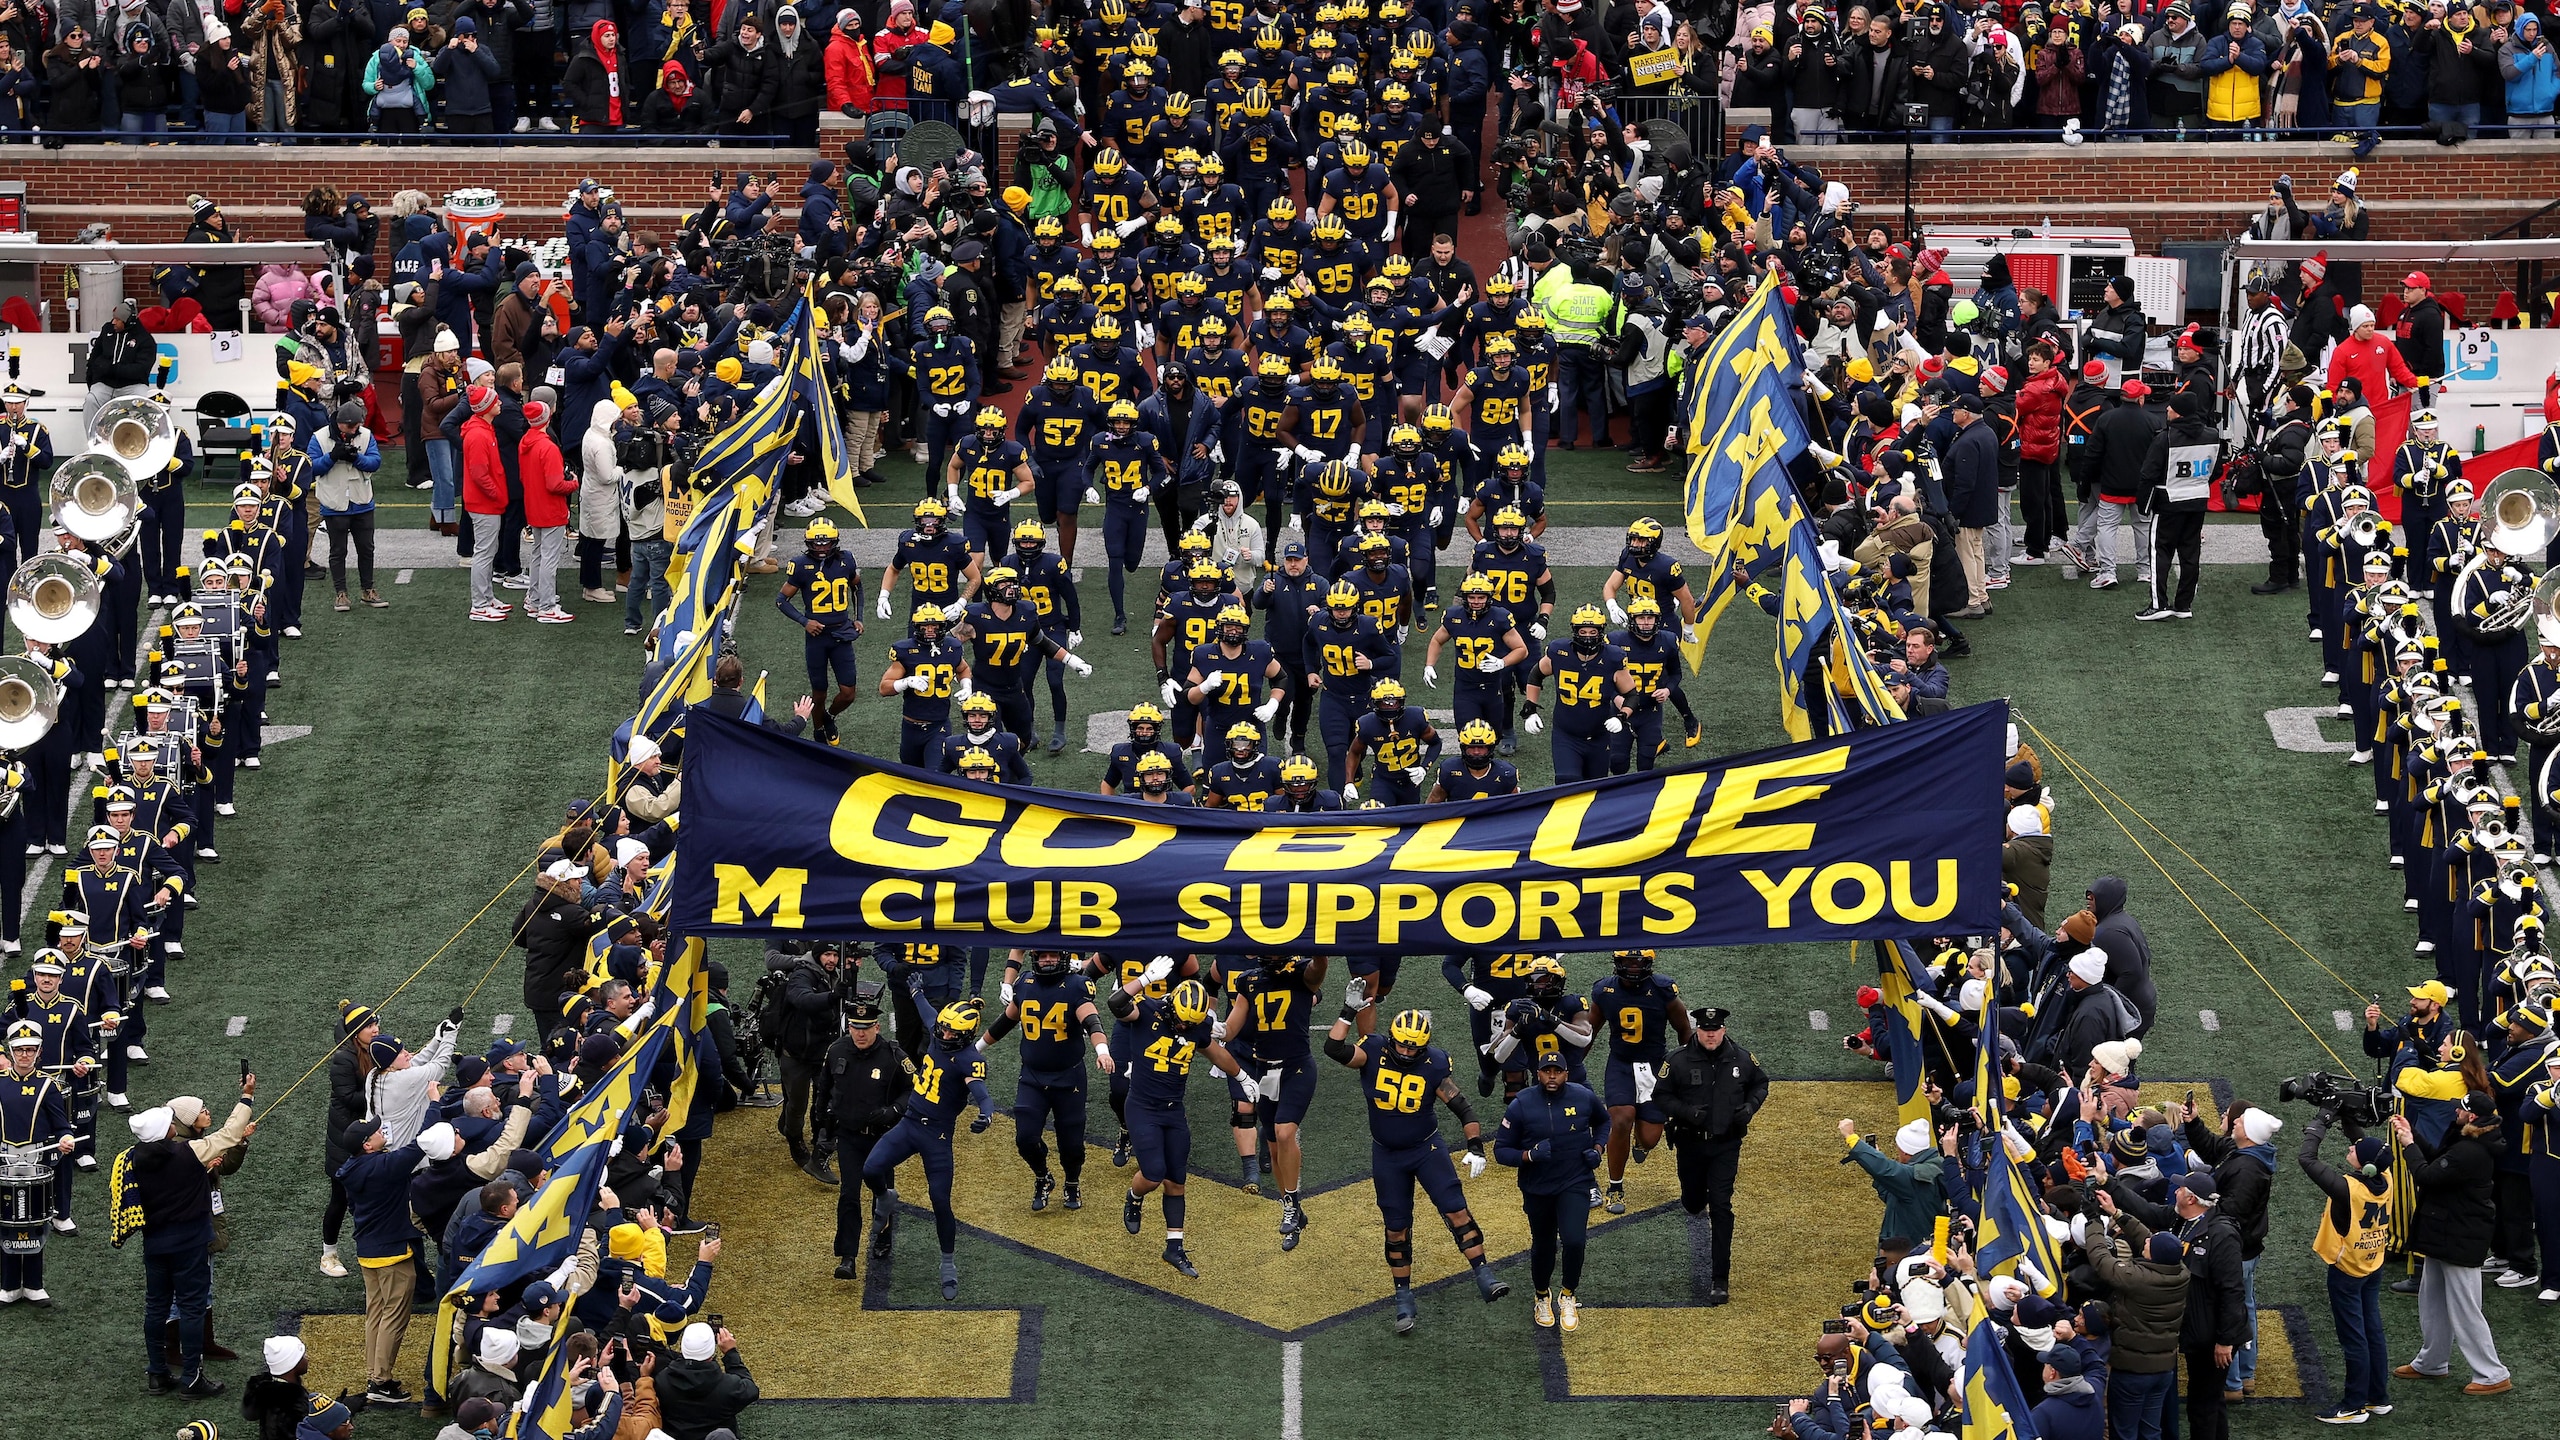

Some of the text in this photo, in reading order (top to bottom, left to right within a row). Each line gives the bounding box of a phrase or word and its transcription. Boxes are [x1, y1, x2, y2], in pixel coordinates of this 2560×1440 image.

[1210, 0, 1245, 30] 53
[1634, 52, 1676, 67] MAKE SOME
[912, 66, 933, 83] EVENT
[912, 78, 932, 94] TEAM
[1093, 194, 1129, 222] 70
[1343, 193, 1379, 220] 90
[1197, 212, 1232, 241] 89
[1264, 247, 1299, 275] 59
[1317, 263, 1354, 294] 95
[1092, 283, 1127, 313] 23
[1572, 295, 1596, 306] STATE
[1570, 305, 1597, 316] POLICE
[1973, 342, 1997, 365] M
[928, 365, 966, 397] 22
[1083, 371, 1120, 402] 92
[156, 395, 164, 403] M
[1480, 398, 1519, 425] 86
[276, 418, 285, 426] M
[1311, 409, 1342, 439] 17
[2326, 423, 2335, 432] M
[18, 431, 29, 440] M
[1043, 418, 1083, 447] 57
[701, 476, 712, 486] M
[968, 466, 1006, 499] 40
[1104, 459, 1143, 490] 84
[2350, 491, 2359, 499] M
[2455, 485, 2464, 493] M
[1389, 483, 1427, 514] 39
[234, 559, 242, 567] M
[909, 562, 949, 593] 88
[1487, 570, 1529, 604] 76
[2391, 587, 2400, 596] M
[811, 577, 848, 615] 20
[184, 608, 194, 616] M
[1185, 617, 1218, 651] 9
[985, 633, 1027, 666] 77
[1455, 637, 1495, 671] 32
[1322, 645, 1354, 677] 91
[168, 667, 178, 675] M
[1219, 672, 1251, 706] 71
[1558, 669, 1604, 708] 54
[151, 695, 161, 703] M
[139, 744, 149, 752] M
[1377, 737, 1420, 772] 42
[114, 793, 124, 801] M
[2477, 793, 2488, 801] M
[828, 745, 1852, 872] GO BLUE
[2506, 842, 2518, 850] M
[106, 882, 117, 890] M
[710, 859, 1958, 944] M CLUB SUPPORTS YOU
[590, 912, 601, 923] M
[44, 955, 56, 965] M
[2531, 962, 2542, 972] M
[73, 968, 85, 976] M
[1248, 984, 1254, 992] C
[1254, 989, 1292, 1032] 17
[1019, 999, 1069, 1043] 64
[1152, 1022, 1158, 1031] C
[1619, 1006, 1644, 1044] 9
[20, 1027, 32, 1038] M
[553, 1037, 565, 1048] M
[1144, 1035, 1197, 1077] 44
[1380, 1057, 1386, 1066] C
[1547, 1053, 1559, 1062] M
[971, 1061, 987, 1079] 31
[1637, 1062, 1647, 1072] M
[913, 1053, 945, 1105] 31
[22, 1086, 35, 1094] M
[1374, 1067, 1428, 1114] 58
[1565, 1108, 1576, 1116] M
[18, 1197, 26, 1220] YAMAHA
[2359, 1201, 2390, 1229] M
[11, 1239, 41, 1249] YAMAHA
[18, 1231, 29, 1241] M
[460, 1292, 474, 1303] M
